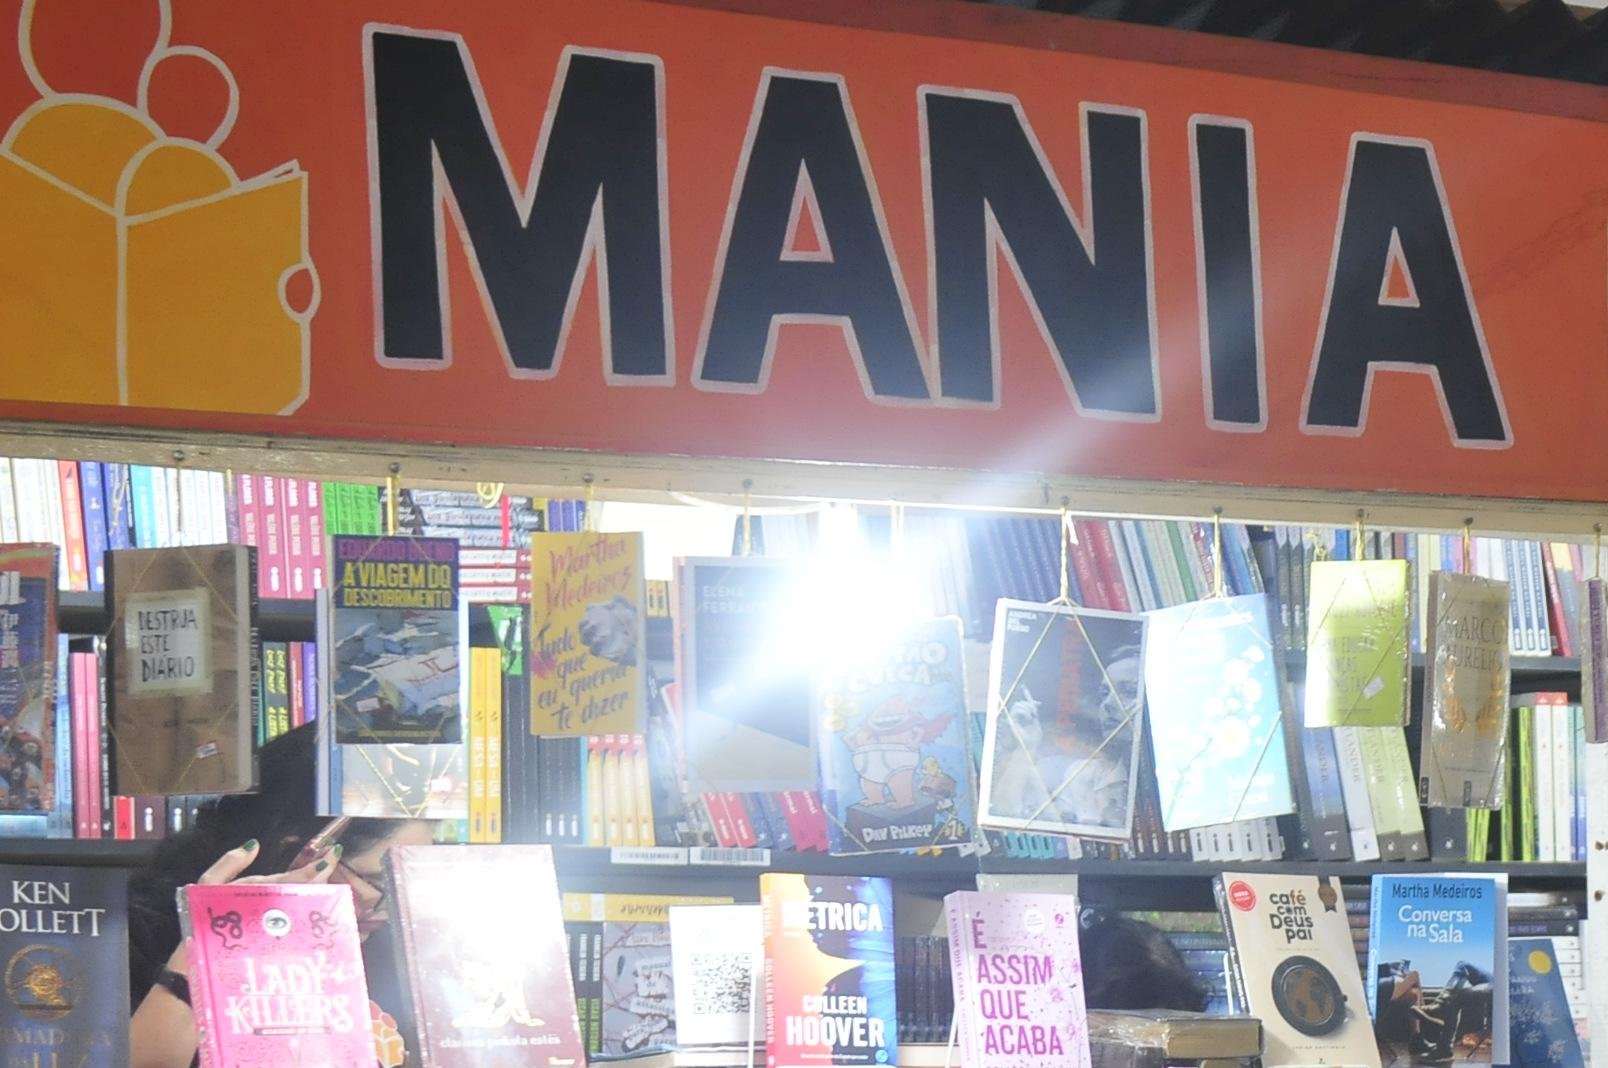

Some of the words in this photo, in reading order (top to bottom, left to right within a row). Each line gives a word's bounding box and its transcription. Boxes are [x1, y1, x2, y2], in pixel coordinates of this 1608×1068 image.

[362, 23, 1514, 449] MANIA
[344, 563, 356, 587] A
[358, 563, 425, 588] VIAGEM
[141, 634, 173, 654] ESTE
[12, 880, 71, 905] KEN
[1392, 881, 1430, 900] Martha
[1432, 882, 1483, 900] Medeiros
[1270, 913, 1314, 930] Deus
[1398, 905, 1473, 924] Conversa
[971, 911, 987, 949] É
[1407, 923, 1427, 938] na
[1428, 924, 1464, 944] Sala
[977, 954, 1053, 985] ASSIM
[803, 994, 868, 1014] COLLEEN
[980, 990, 1029, 1020] QUE
[786, 1015, 886, 1048] HOOVER
[984, 1025, 1064, 1056] ACABA
